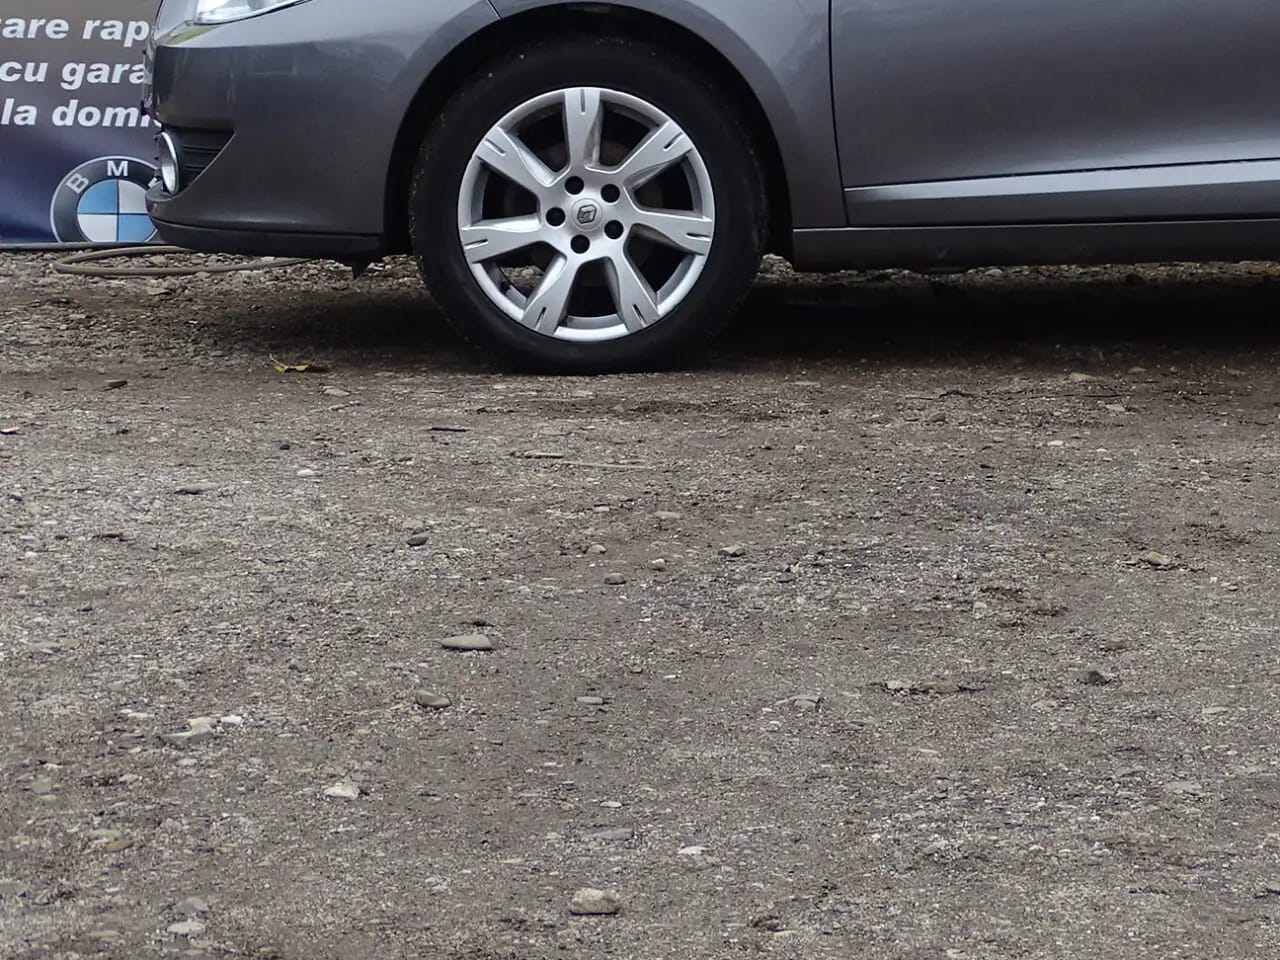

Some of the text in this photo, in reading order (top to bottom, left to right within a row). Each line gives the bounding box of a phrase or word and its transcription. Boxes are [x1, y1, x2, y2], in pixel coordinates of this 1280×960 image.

[0, 17, 69, 40] are
[0, 60, 48, 83] cu
[1, 98, 38, 127] la
